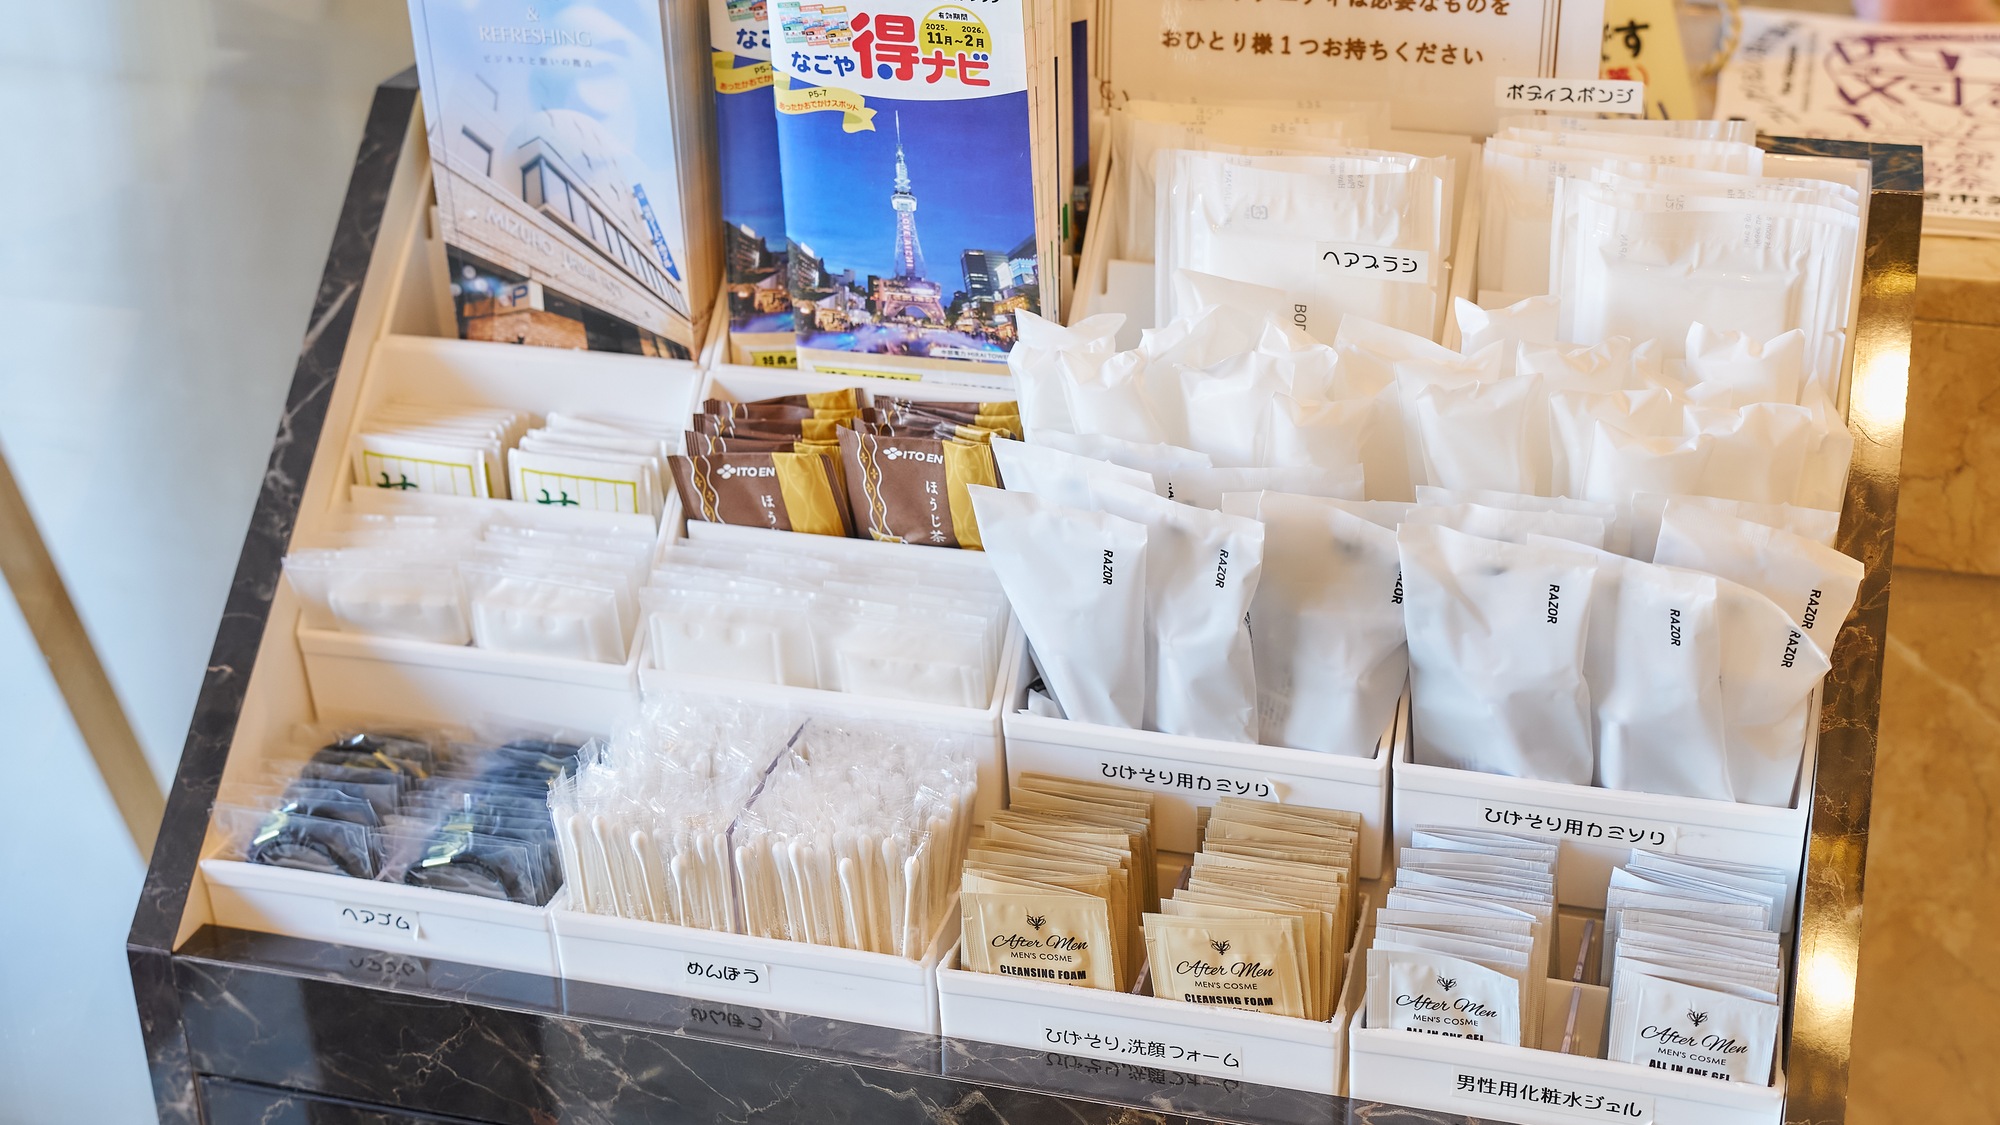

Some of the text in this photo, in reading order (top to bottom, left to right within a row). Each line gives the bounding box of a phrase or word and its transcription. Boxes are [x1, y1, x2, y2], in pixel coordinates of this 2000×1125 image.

[527, 5, 540, 22] &
[938, 12, 969, 21] 有効期間
[478, 25, 593, 48] REFRESHING
[926, 23, 984, 34] 2025. 2026.
[808, 90, 827, 98] P5-7
[1506, 83, 1634, 104] ボディスポンジ
[778, 100, 859, 111] あったかおでかけスポット
[1323, 251, 1418, 273] ヘアブラシ
[511, 285, 529, 307] P
[760, 495, 780, 531] ほう
[925, 480, 947, 543] ほうじ茶
[1102, 548, 1114, 585] RAZOR
[1215, 548, 1229, 588] RAZOR
[1546, 583, 1560, 624] RAZOR
[1801, 589, 1822, 630] RAZOR
[1670, 608, 1681, 647] RAZOR
[1781, 630, 1801, 668] RAZOR
[1101, 762, 1270, 799] ひげそり用カミソリ
[1484, 806, 1666, 846] ひげそり用カミソリ
[342, 907, 411, 931] ヘアゴム
[992, 934, 1088, 951] After Men
[1010, 951, 1073, 963] MEN'S COSME
[687, 961, 760, 984] めんぼう
[1000, 964, 1087, 981] CLEANSING FOAM
[1176, 960, 1274, 979] After Men
[1194, 980, 1258, 990] MEN'S COSME
[1184, 993, 1274, 1006] CLEANSING FOAM
[1395, 993, 1498, 1019] After Men
[1413, 1013, 1479, 1027] MEN'S COSME
[1641, 1023, 1748, 1055] After Men
[1648, 1058, 1667, 1070] ALL
[1670, 1063, 1684, 1073] IN
[1686, 1067, 1708, 1077] ONE
[1657, 1047, 1727, 1066] MEN'S COSME
[1457, 1074, 1642, 1118] 男性用化粧水ジェル
